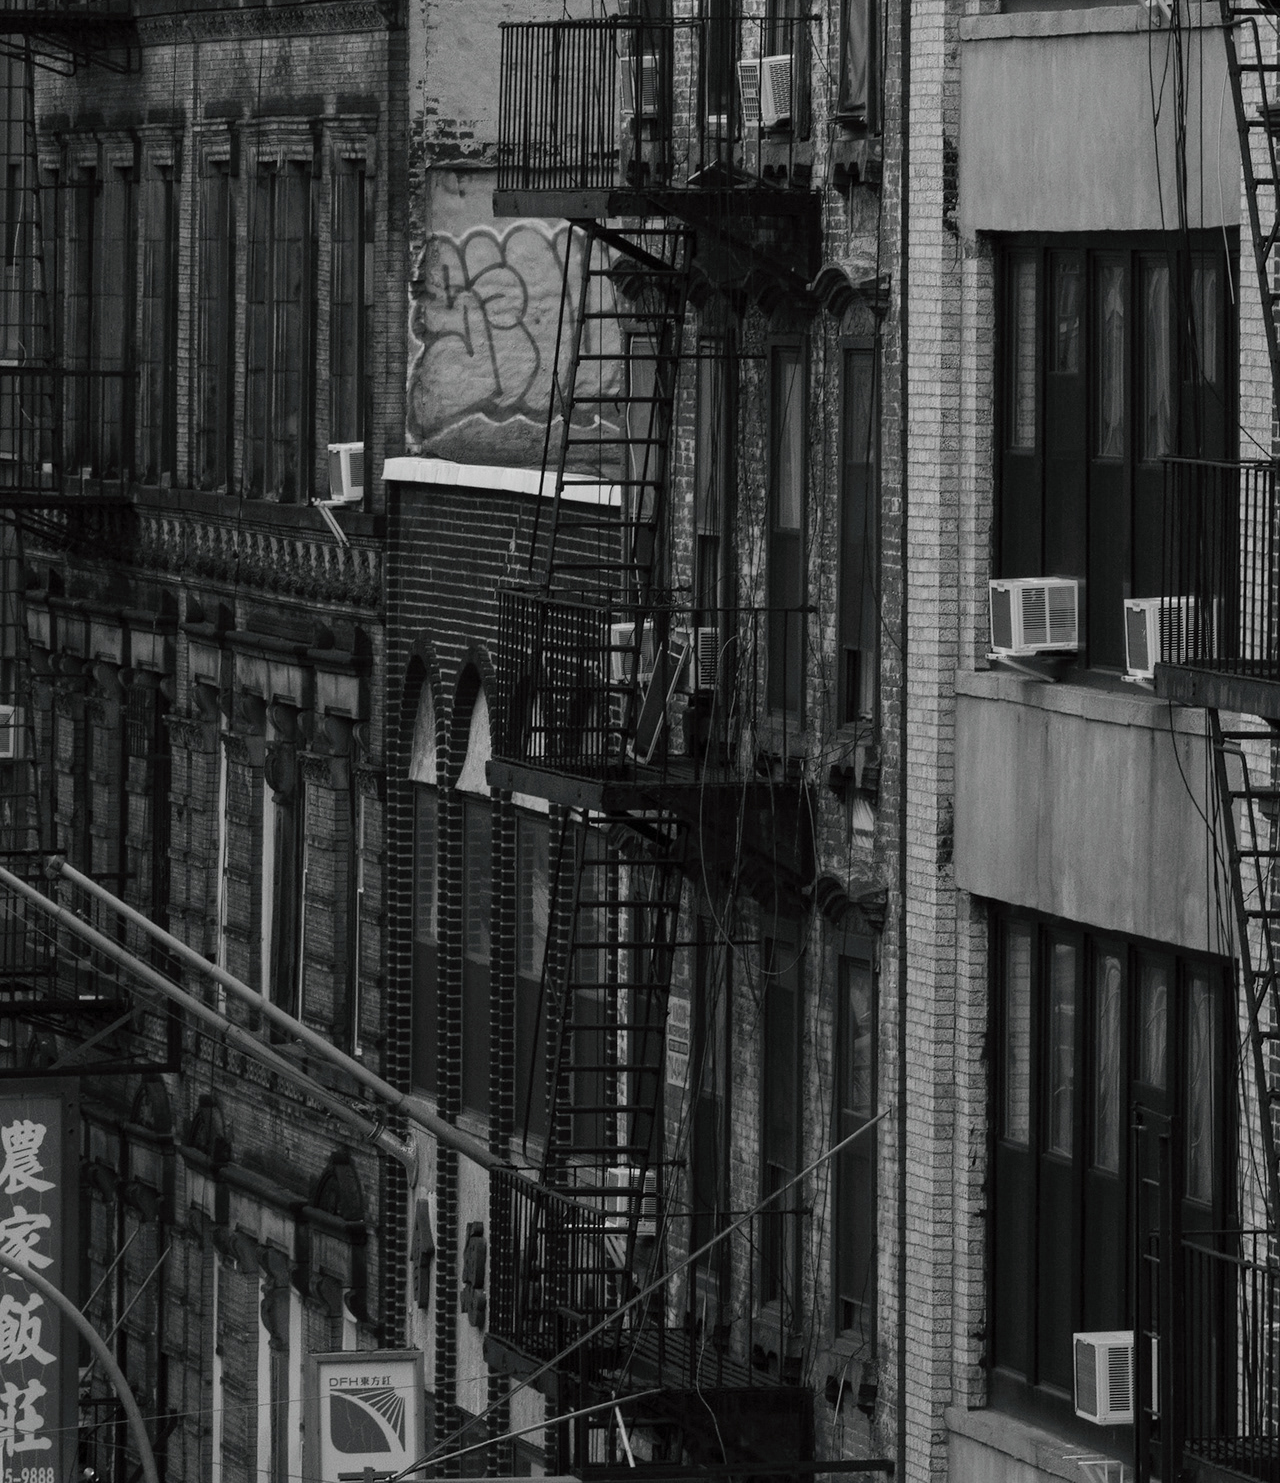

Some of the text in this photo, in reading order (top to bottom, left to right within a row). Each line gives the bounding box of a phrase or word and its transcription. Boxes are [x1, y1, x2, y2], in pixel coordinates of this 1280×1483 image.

[328, 1375, 392, 1387] DFH 東方紅
